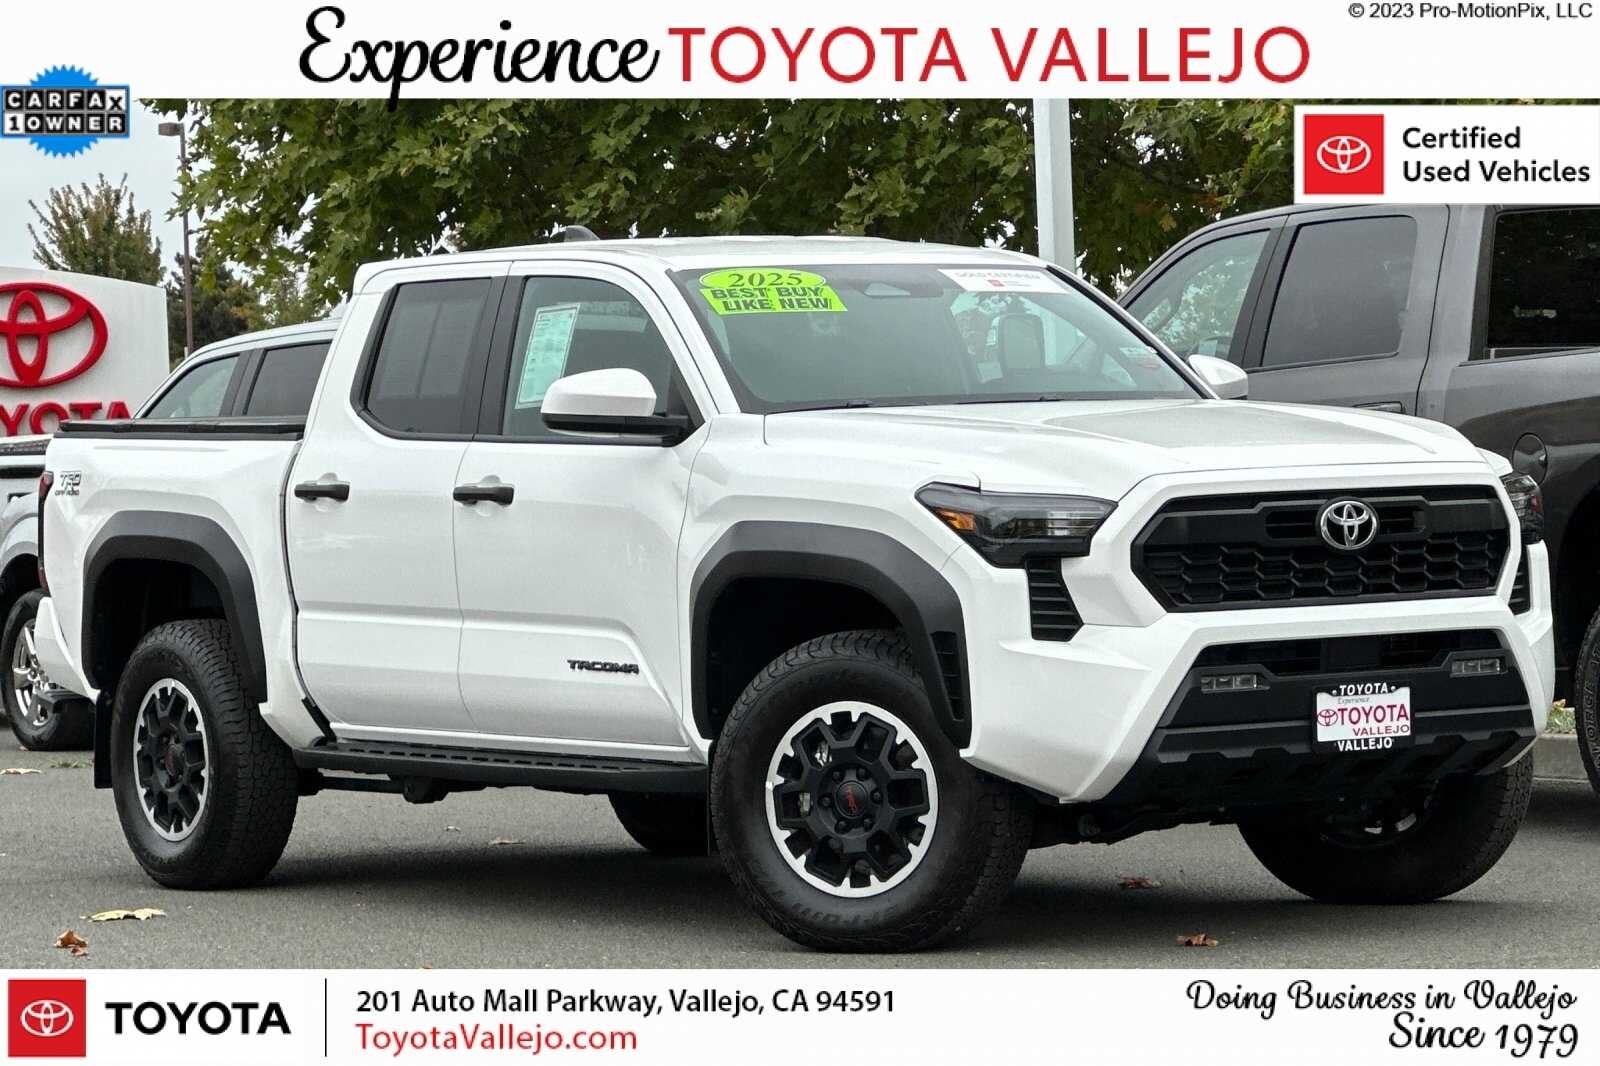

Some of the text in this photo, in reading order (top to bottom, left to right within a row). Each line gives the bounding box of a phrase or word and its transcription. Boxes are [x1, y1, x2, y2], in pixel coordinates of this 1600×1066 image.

[727, 272, 804, 288] 2025
[710, 287, 824, 299] BEST BUY
[721, 299, 773, 311] LIKE
[566, 659, 639, 676] TACOMA
[1339, 682, 1389, 696] TOYOTA
[1337, 703, 1410, 726] TOYOTA
[1352, 724, 1410, 737] VALLEJO
[1337, 737, 1393, 752] VALLEJO
